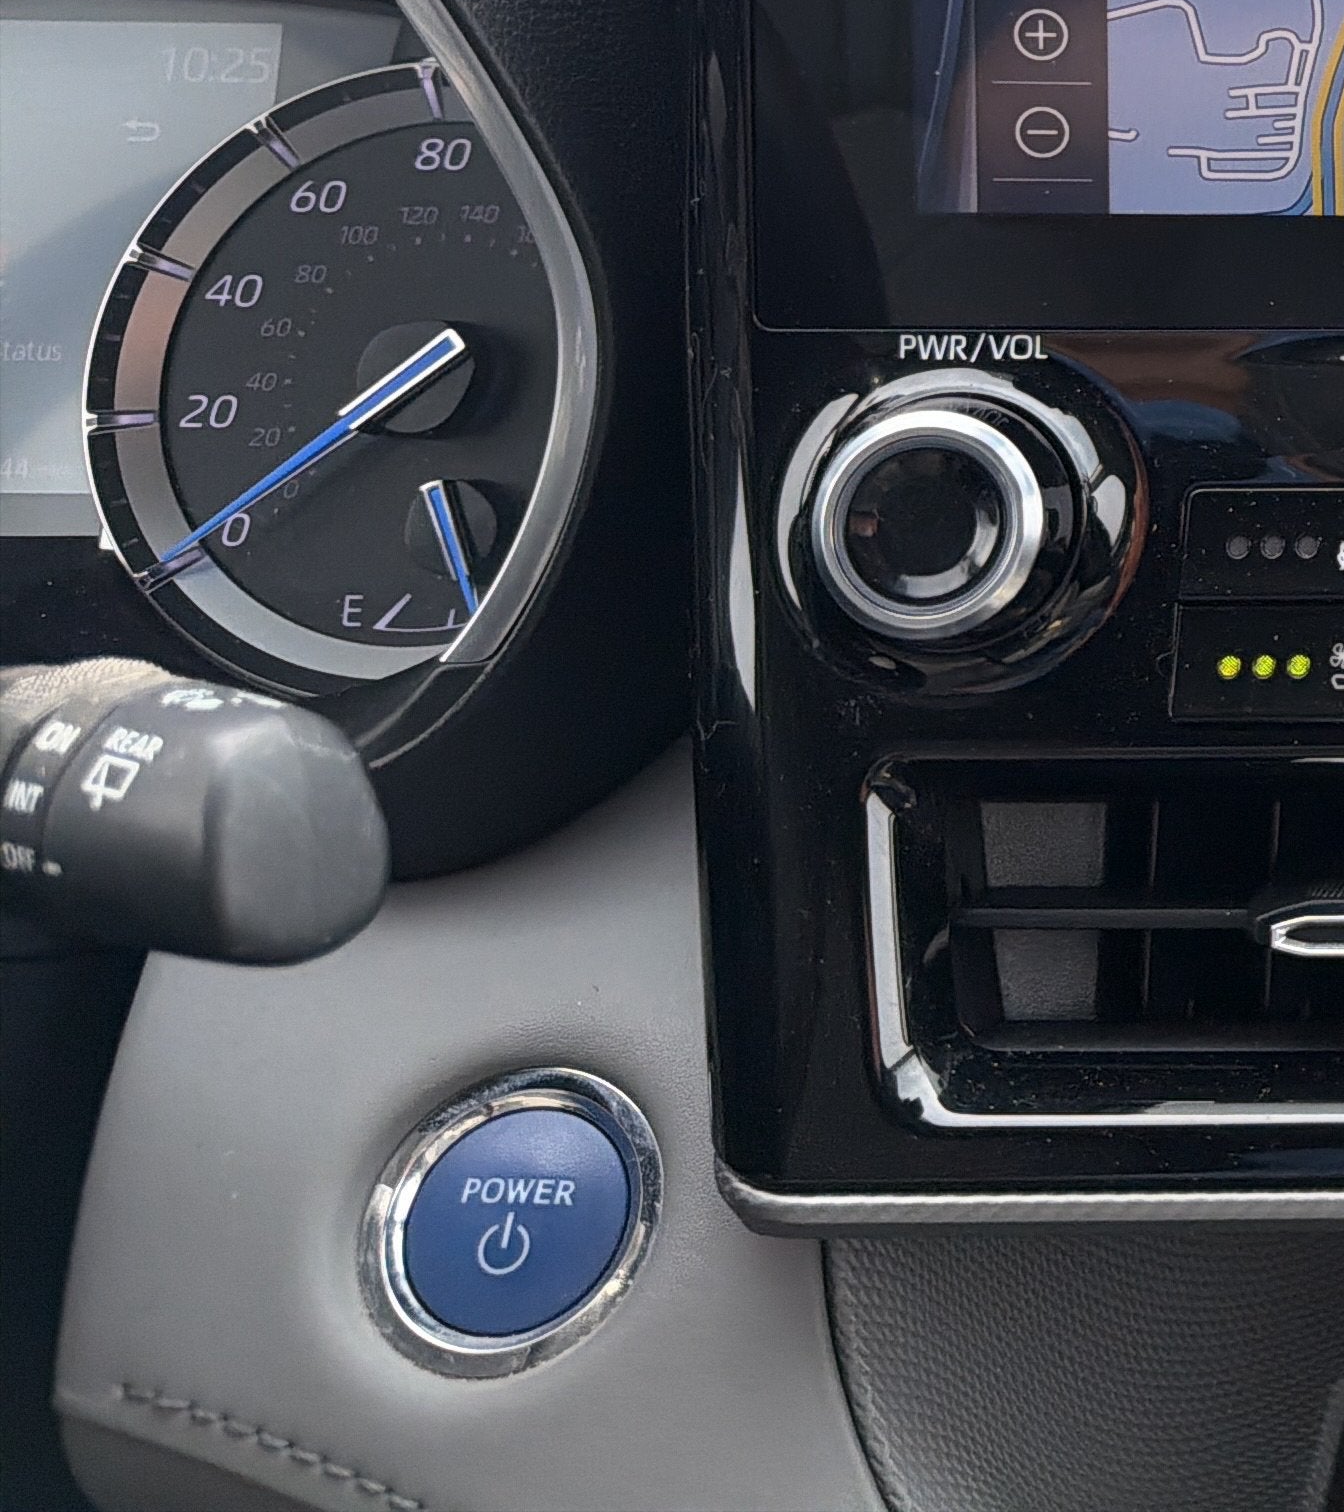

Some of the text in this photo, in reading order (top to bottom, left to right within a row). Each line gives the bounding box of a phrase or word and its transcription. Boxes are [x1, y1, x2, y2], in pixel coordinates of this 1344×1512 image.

[160, 47, 272, 84] 10:25
[414, 138, 472, 171] 80
[290, 179, 347, 213] 60
[401, 205, 439, 225] 120
[460, 204, 500, 224] 140
[341, 225, 379, 245] 100
[294, 264, 327, 284] 80
[205, 274, 263, 308] 40
[260, 318, 292, 338] 60
[900, 333, 1049, 363] PWR/VOL
[246, 371, 278, 391] 40
[179, 394, 238, 429] 20
[249, 427, 281, 447] 20
[283, 480, 299, 500] 0
[220, 512, 250, 546] 0
[342, 595, 364, 628] E
[34, 720, 81, 755] ON
[104, 726, 164, 763] REAR
[4, 779, 44, 814] INT
[0, 841, 36, 873] OFF
[460, 1177, 576, 1207] POWER
